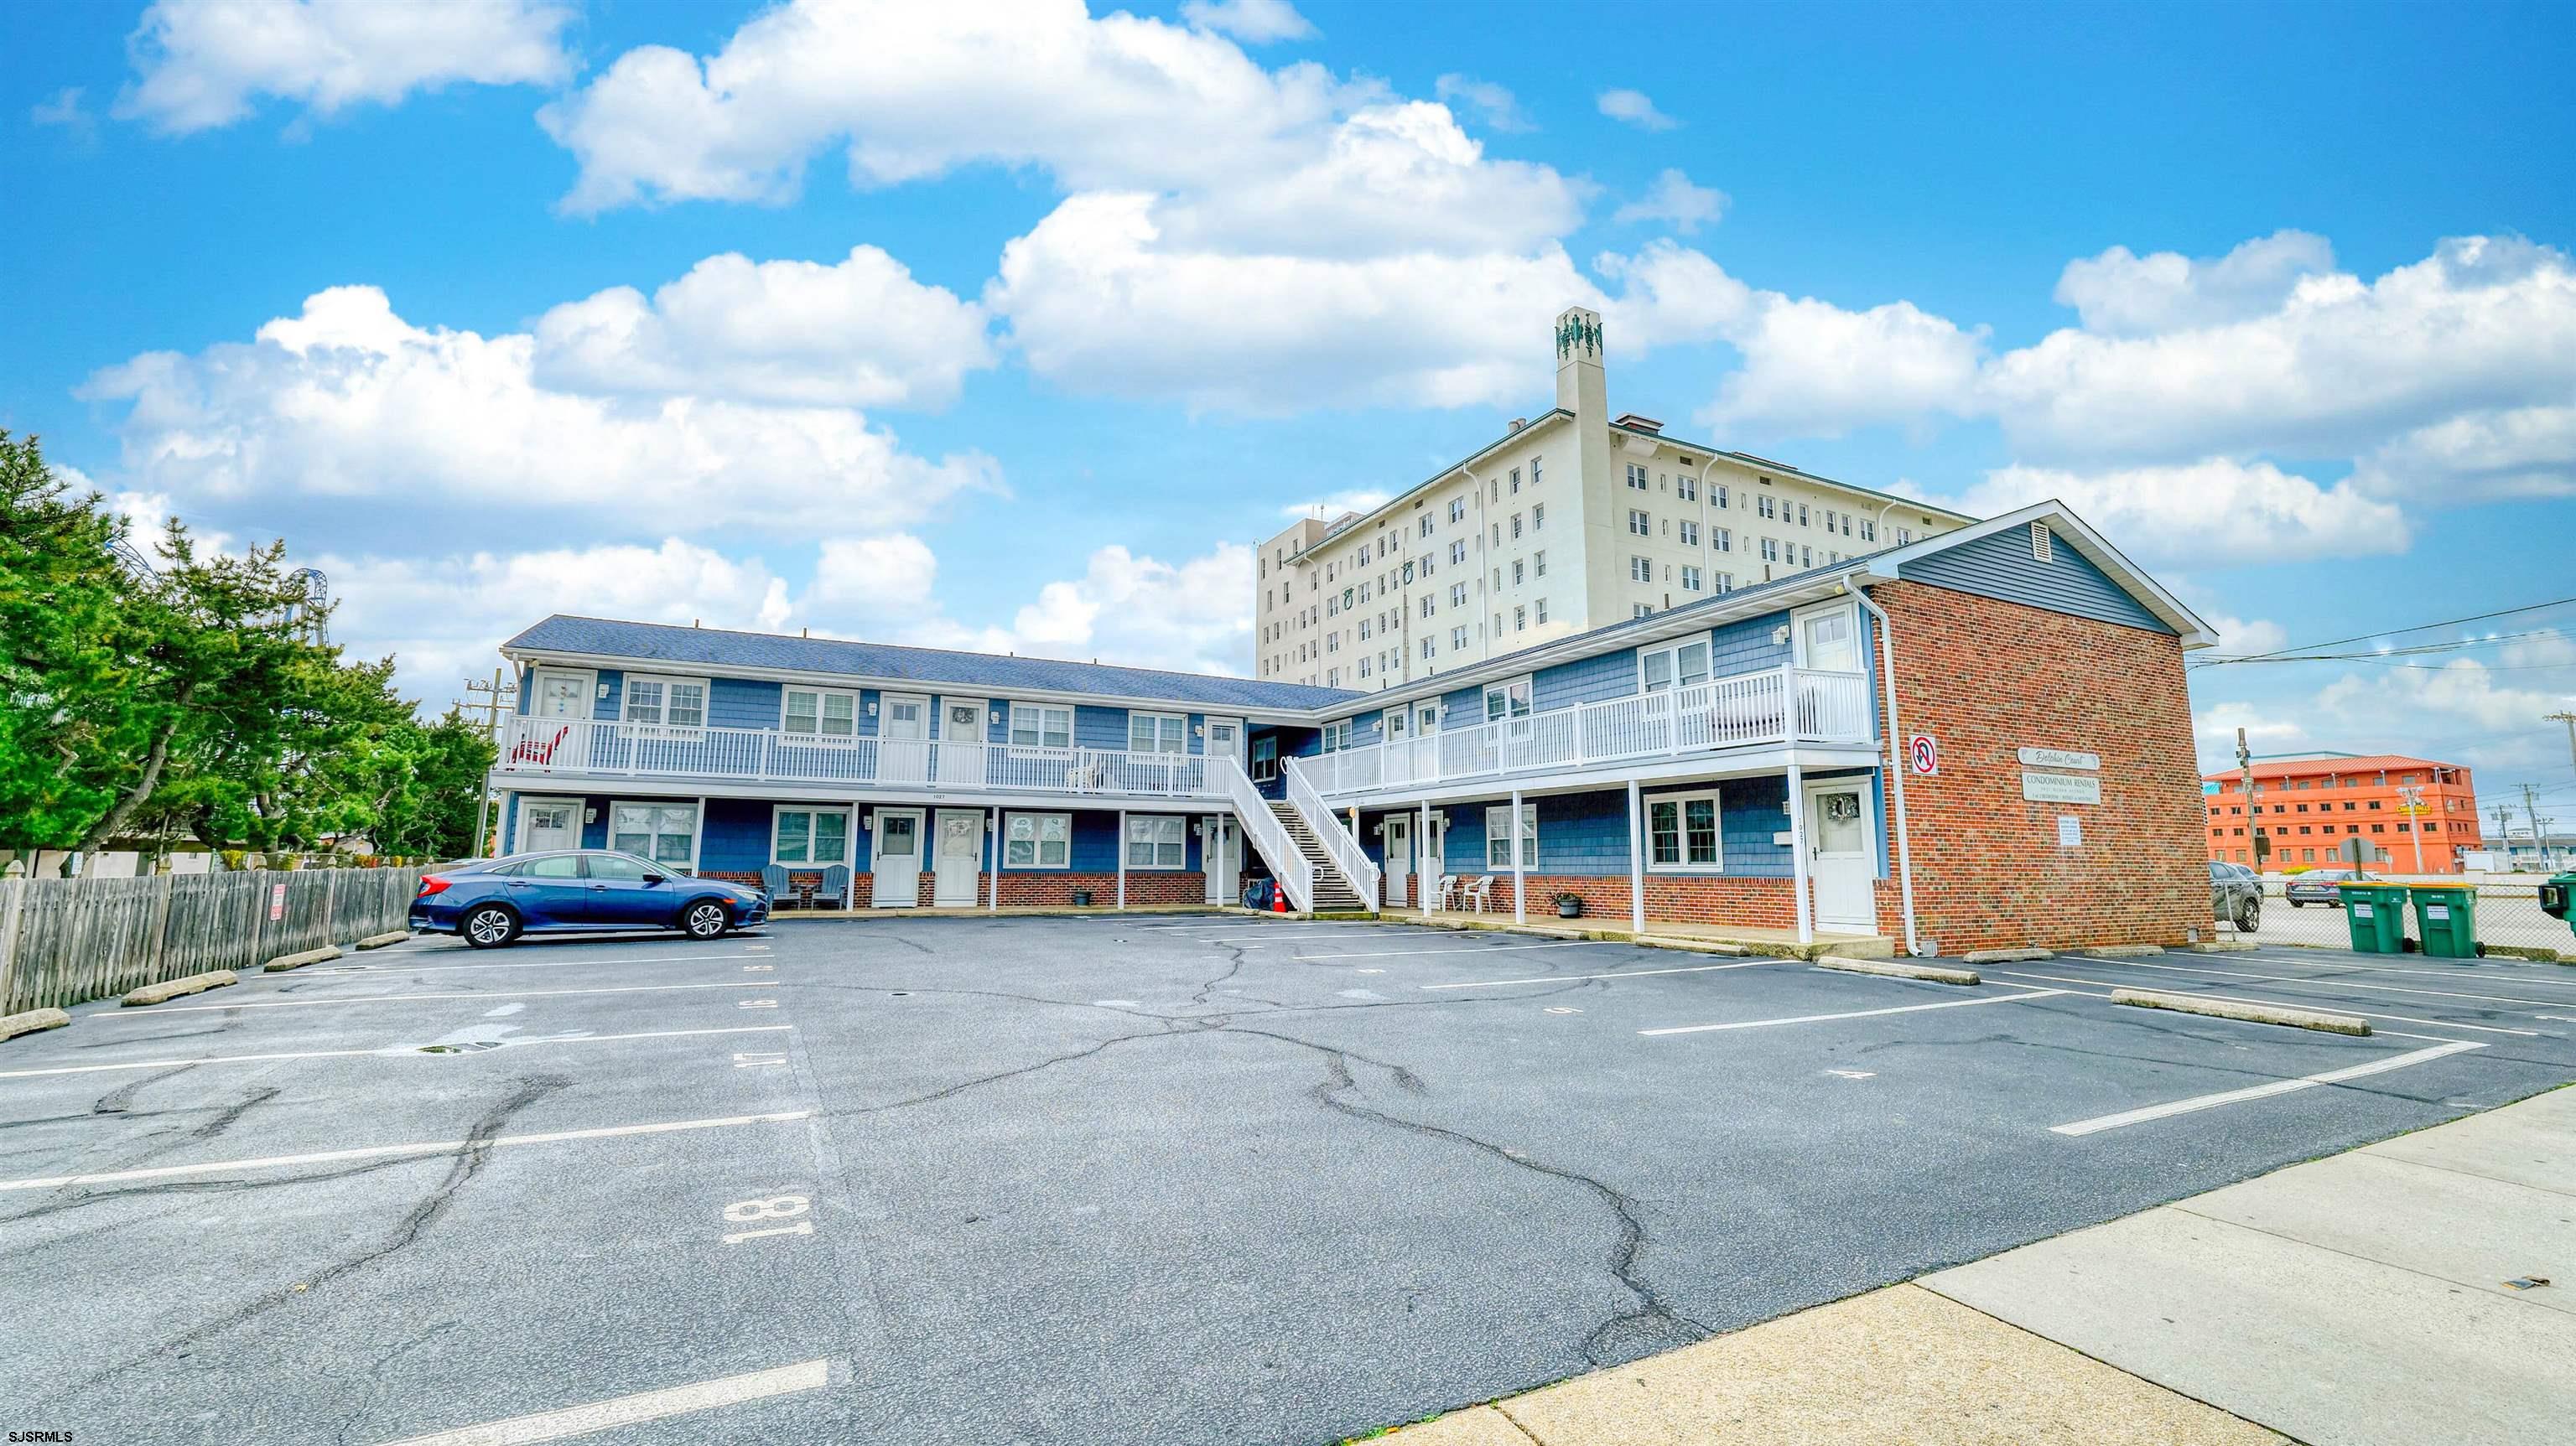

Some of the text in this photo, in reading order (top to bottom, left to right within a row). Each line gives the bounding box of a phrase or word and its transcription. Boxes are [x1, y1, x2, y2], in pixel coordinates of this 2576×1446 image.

[2035, 750, 2085, 765] Dolphin Court
[2027, 775, 2096, 788] CONDOMINIUM RENTALS
[738, 999, 779, 1009] 16
[733, 1053, 787, 1068] 17
[1826, 1070, 1877, 1080] 4
[723, 1195, 813, 1246] 18
